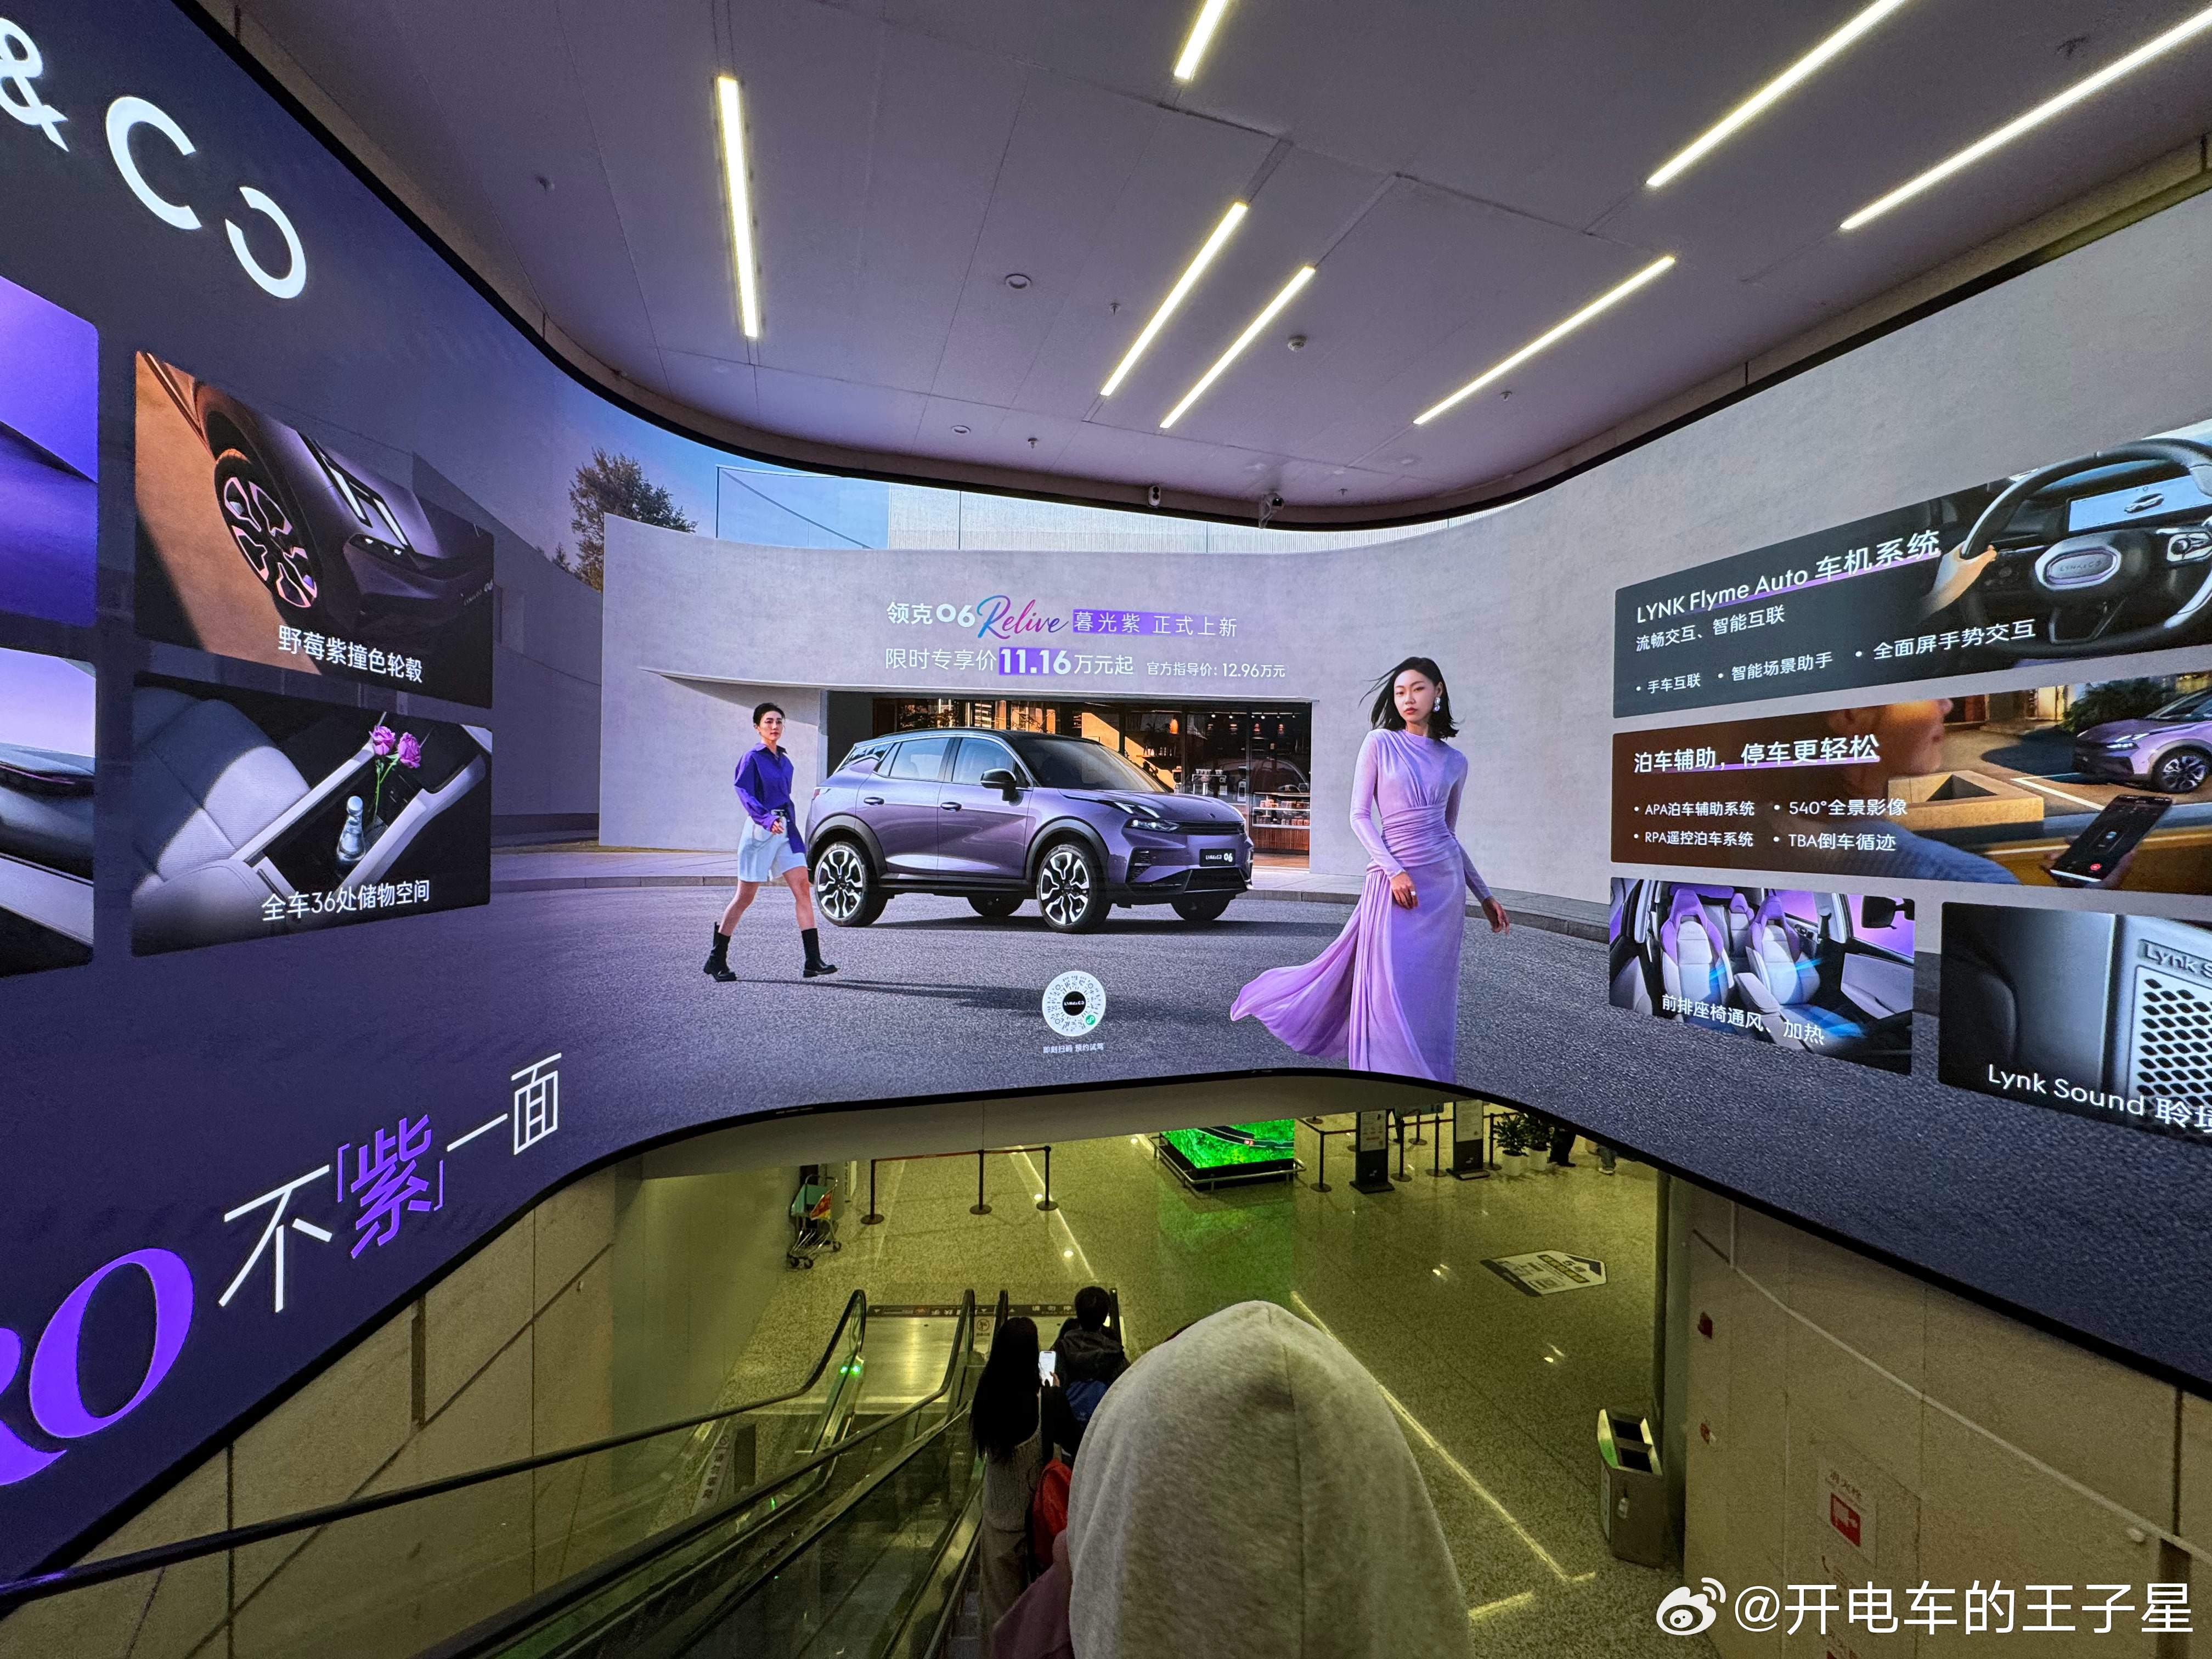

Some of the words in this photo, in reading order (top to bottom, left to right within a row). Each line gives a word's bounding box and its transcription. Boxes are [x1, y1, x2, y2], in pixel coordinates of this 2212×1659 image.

[1637, 595, 1685, 624] LYNK
[1690, 583, 1750, 616] Flyme
[1755, 568, 1808, 595] Auto
[1815, 530, 1940, 581] 车机系统
[886, 601, 975, 628] 领克06
[977, 595, 1069, 640] Relive
[1074, 611, 1141, 634] 暮光紫
[1153, 615, 1237, 637] 正式上新
[278, 624, 423, 684] 野莓紫撞色轮毂
[885, 647, 1134, 676] 限时专享价11.16万元起
[1647, 672, 1701, 694] 手车互联
[1731, 652, 1833, 682] 智能场景助手
[1874, 618, 2036, 660] 全面屏手势交互
[1645, 800, 1755, 817] APA泊车辅助系统
[1789, 798, 1908, 816] 540°全景影像
[1223, 853, 1233, 862] 06
[1645, 831, 1754, 847] RPA遥控泊车系统
[1788, 832, 1896, 851] TBA倒车循迹
[262, 879, 430, 921] 全车36处储物空间
[1662, 994, 1825, 1046] 前排座椅通风、加热
[1989, 1064, 2047, 1094] Lynk
[2053, 1078, 2145, 1116] Sound
